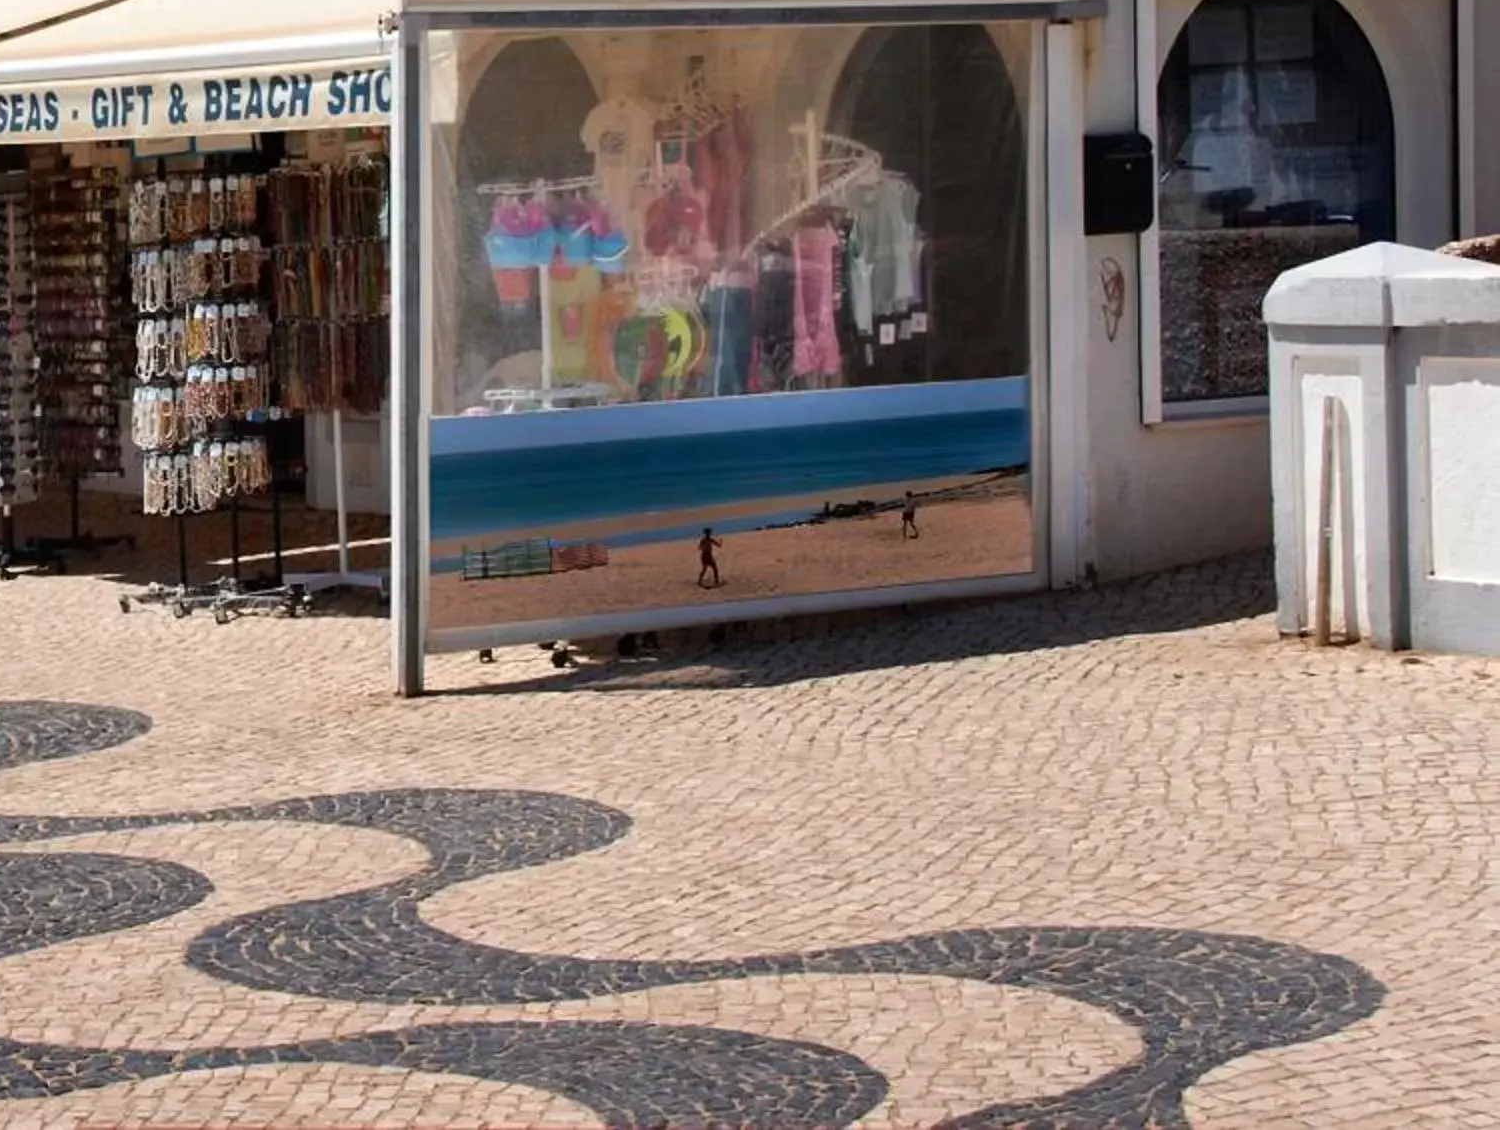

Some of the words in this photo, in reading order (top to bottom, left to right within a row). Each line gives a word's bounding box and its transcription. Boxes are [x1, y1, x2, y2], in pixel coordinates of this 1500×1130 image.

[91, 85, 153, 129] GIFT
[168, 82, 188, 124] &
[203, 73, 313, 122] BEACH
